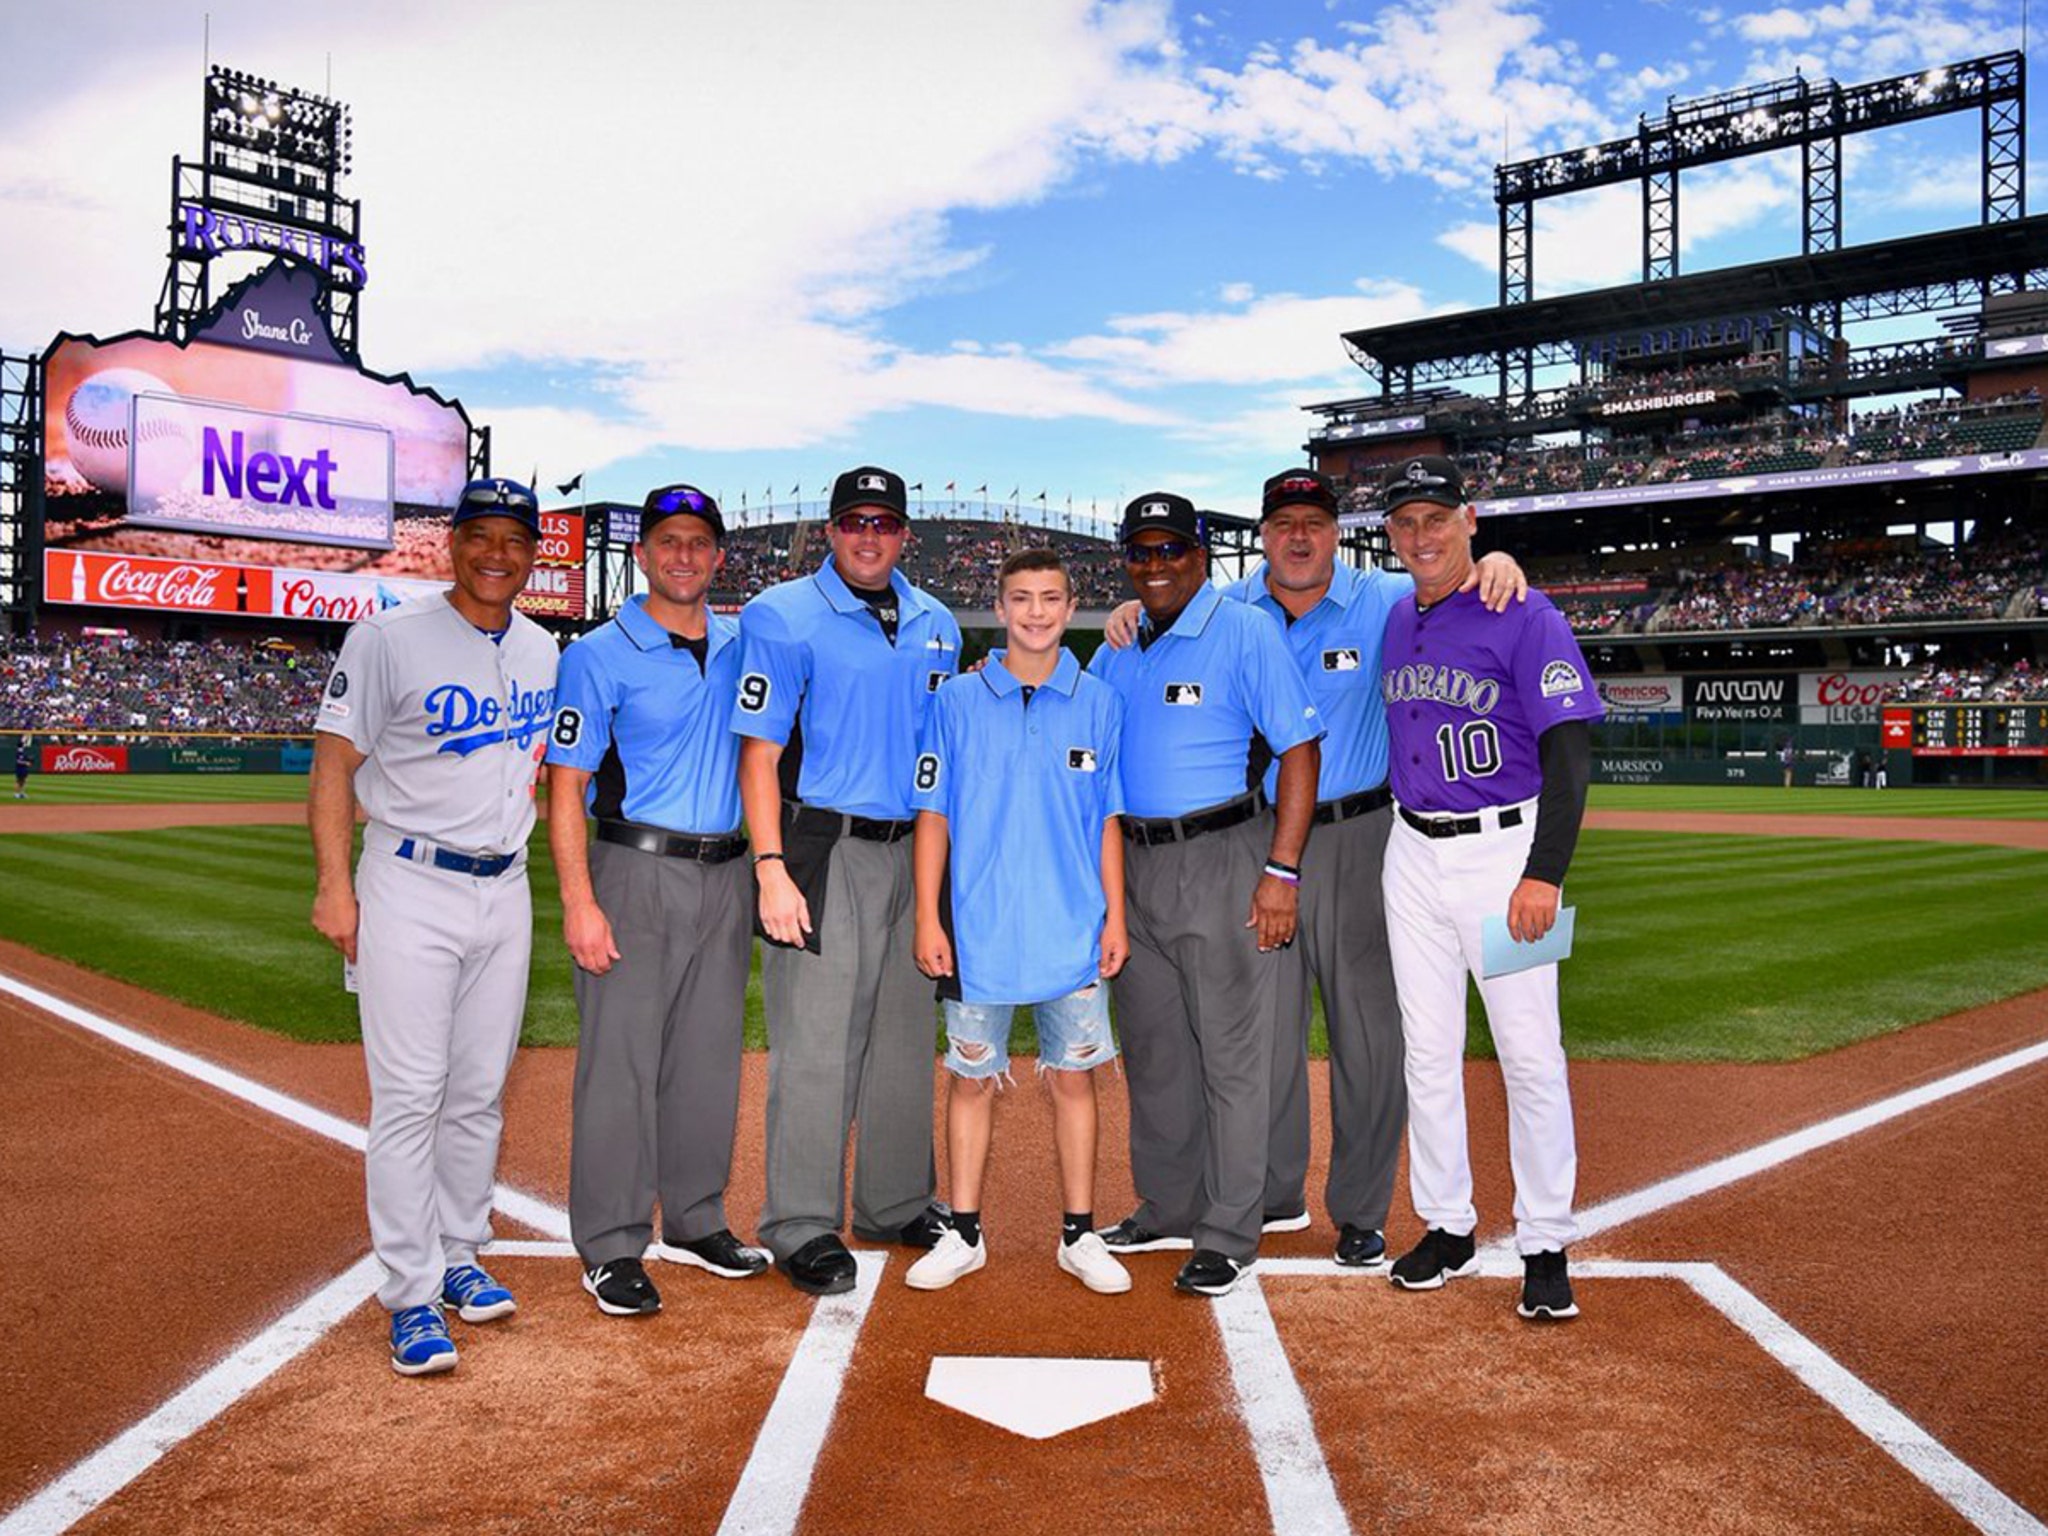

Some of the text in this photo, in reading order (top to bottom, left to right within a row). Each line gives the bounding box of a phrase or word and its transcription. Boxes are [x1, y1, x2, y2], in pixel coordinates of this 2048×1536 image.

[184, 205, 367, 287] ROCKIES
[242, 309, 289, 340] Shane
[1602, 390, 1716, 416] SMASHBURGER
[203, 426, 337, 510] Next
[538, 517, 569, 535] LLS
[98, 560, 222, 607] Coca-Cola
[525, 569, 568, 593] ING
[738, 673, 772, 714] 9
[1384, 663, 1500, 716] LORADO
[1695, 680, 1784, 702] ARROW
[425, 680, 557, 752] Dodger
[553, 706, 584, 749] 8
[1833, 706, 1880, 721] LIGH
[54, 755, 115, 771] Red Robin
[1437, 719, 1502, 782] 10
[1601, 760, 1664, 772] MARSICO
[915, 753, 941, 792] 8
